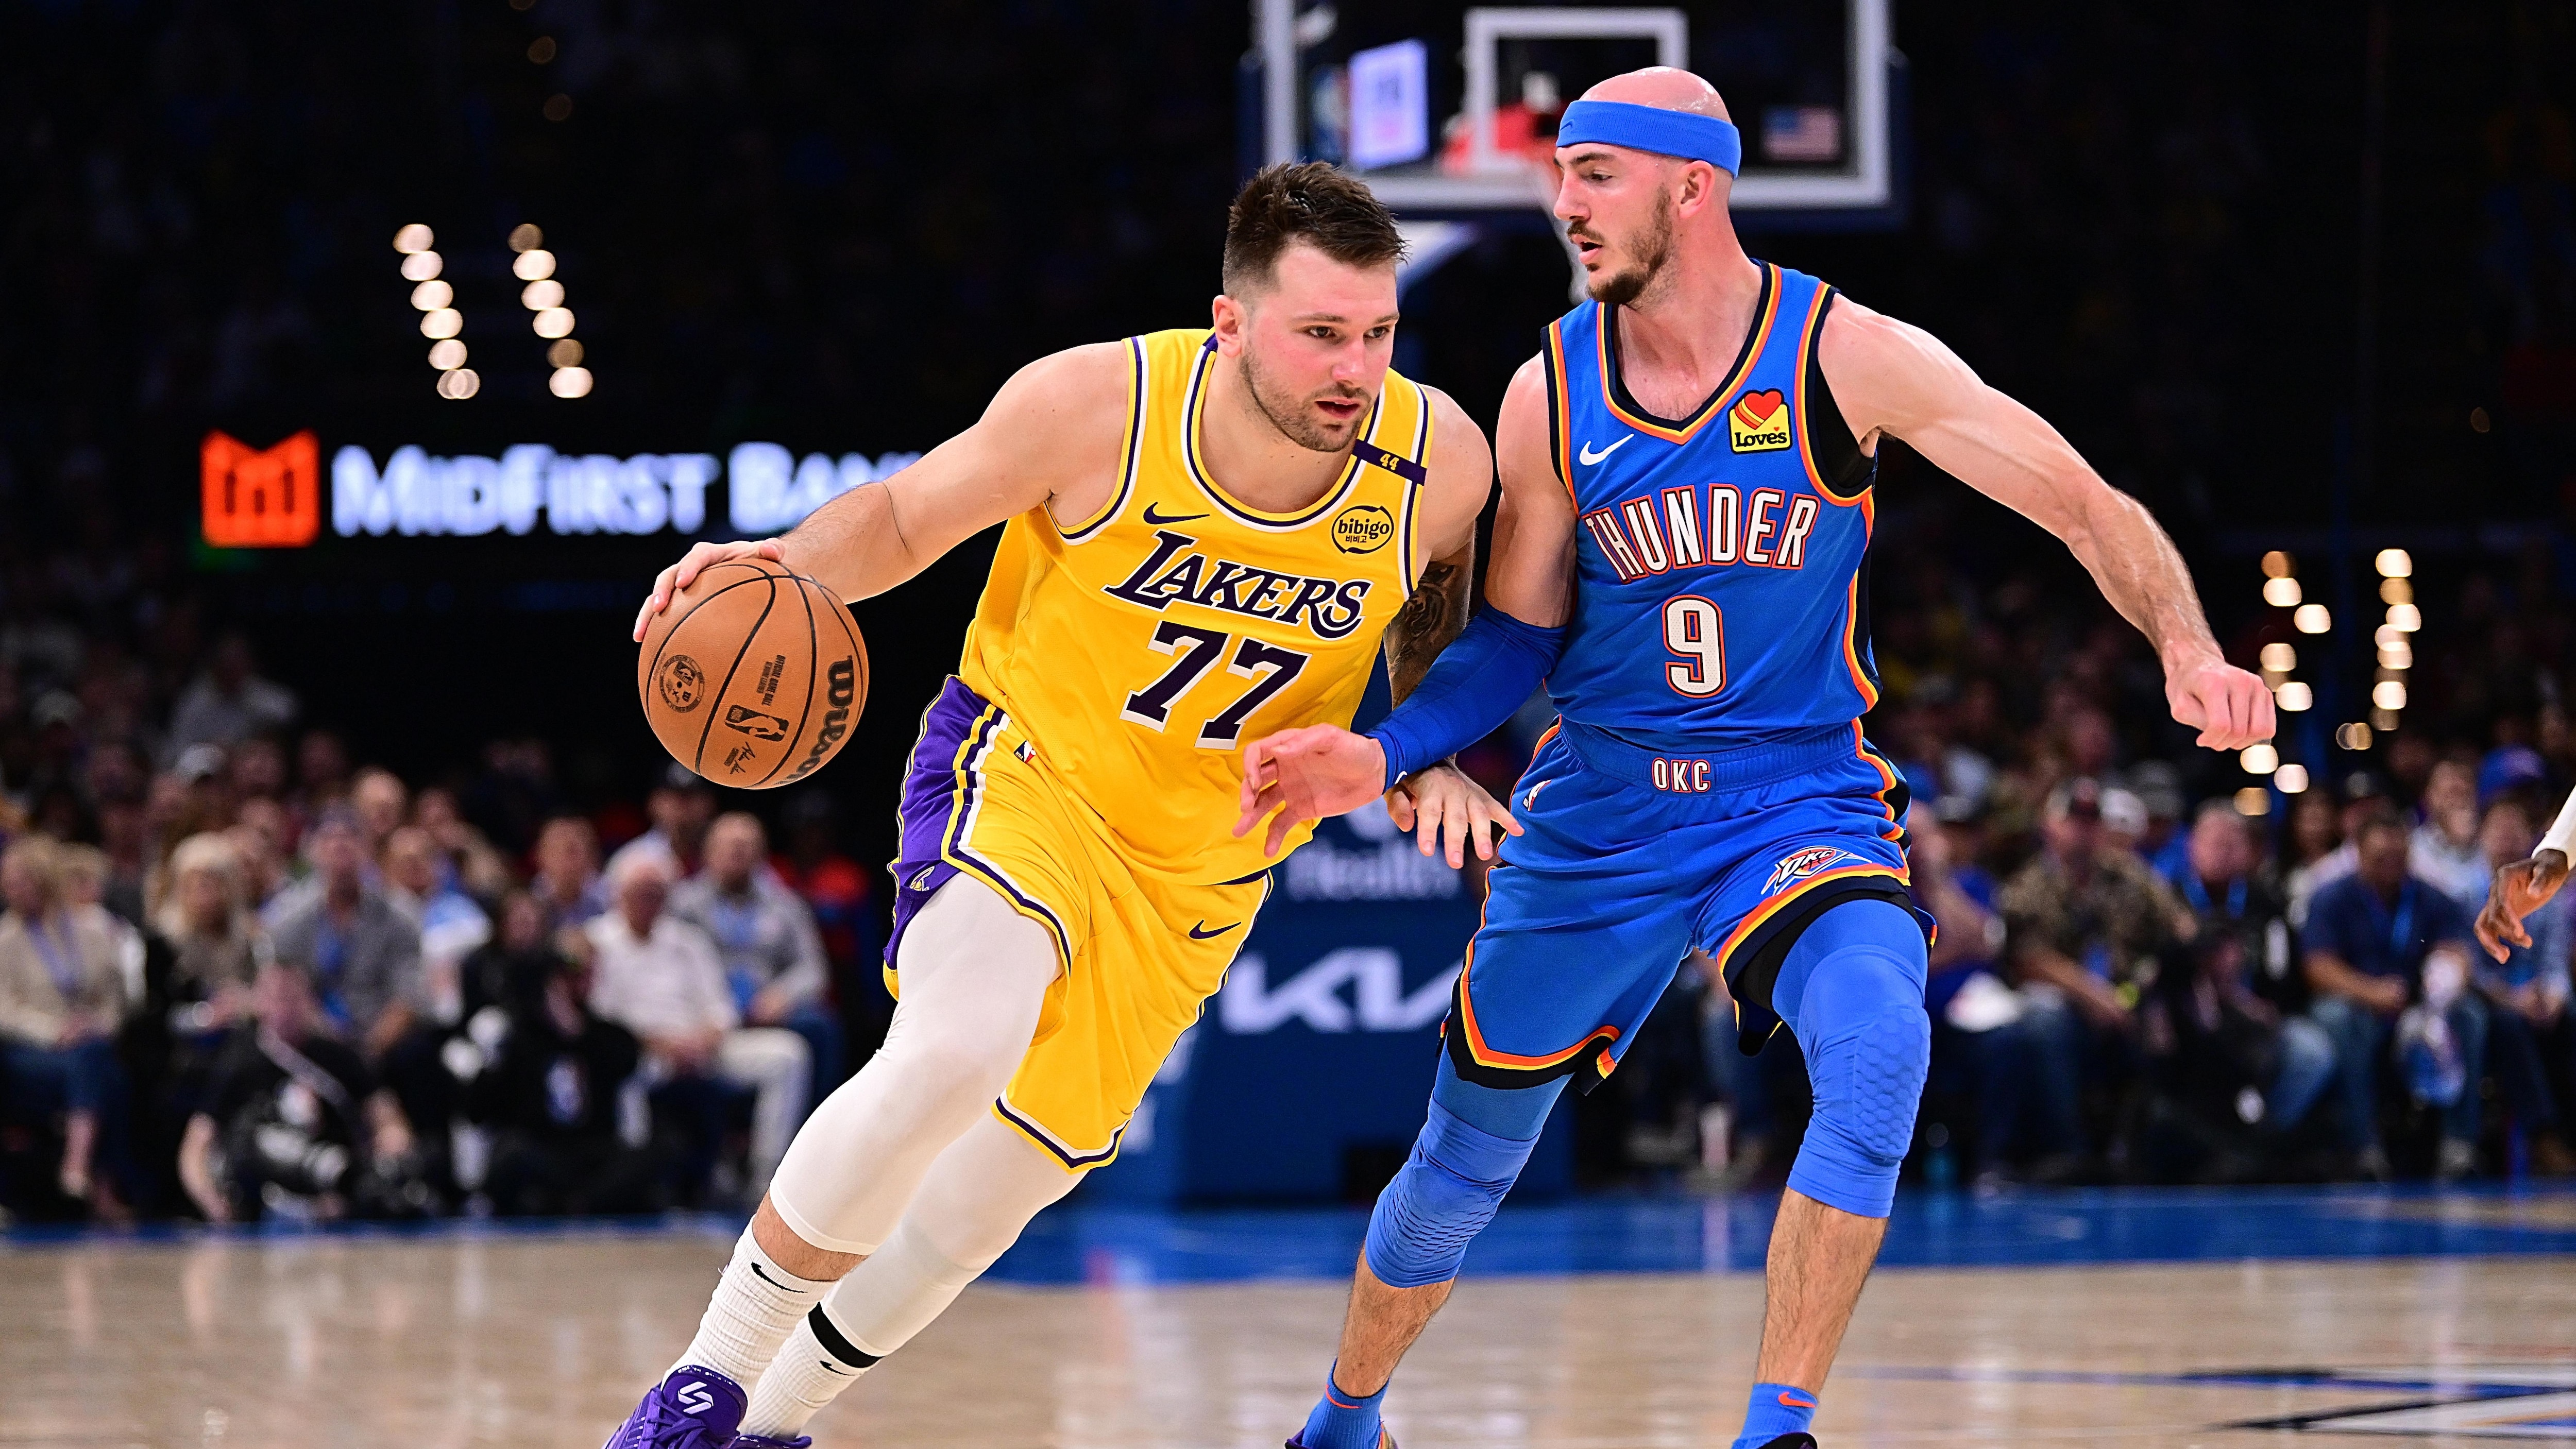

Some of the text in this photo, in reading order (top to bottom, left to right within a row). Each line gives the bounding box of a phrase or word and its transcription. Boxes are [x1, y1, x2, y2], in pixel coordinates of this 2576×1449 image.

[1380, 453, 1400, 471] 44
[727, 441, 925, 534] BA
[1338, 518, 1390, 540] bibigo
[1345, 535, 1367, 543] 비비고
[1582, 483, 1820, 584] THUNDER
[1100, 529, 1372, 641] LAKERS
[1662, 594, 1726, 698] 9
[1119, 620, 1313, 750] 77
[1015, 751, 1023, 760] NBA
[1652, 757, 1711, 793] OKC
[1777, 850, 1833, 884] OKC
